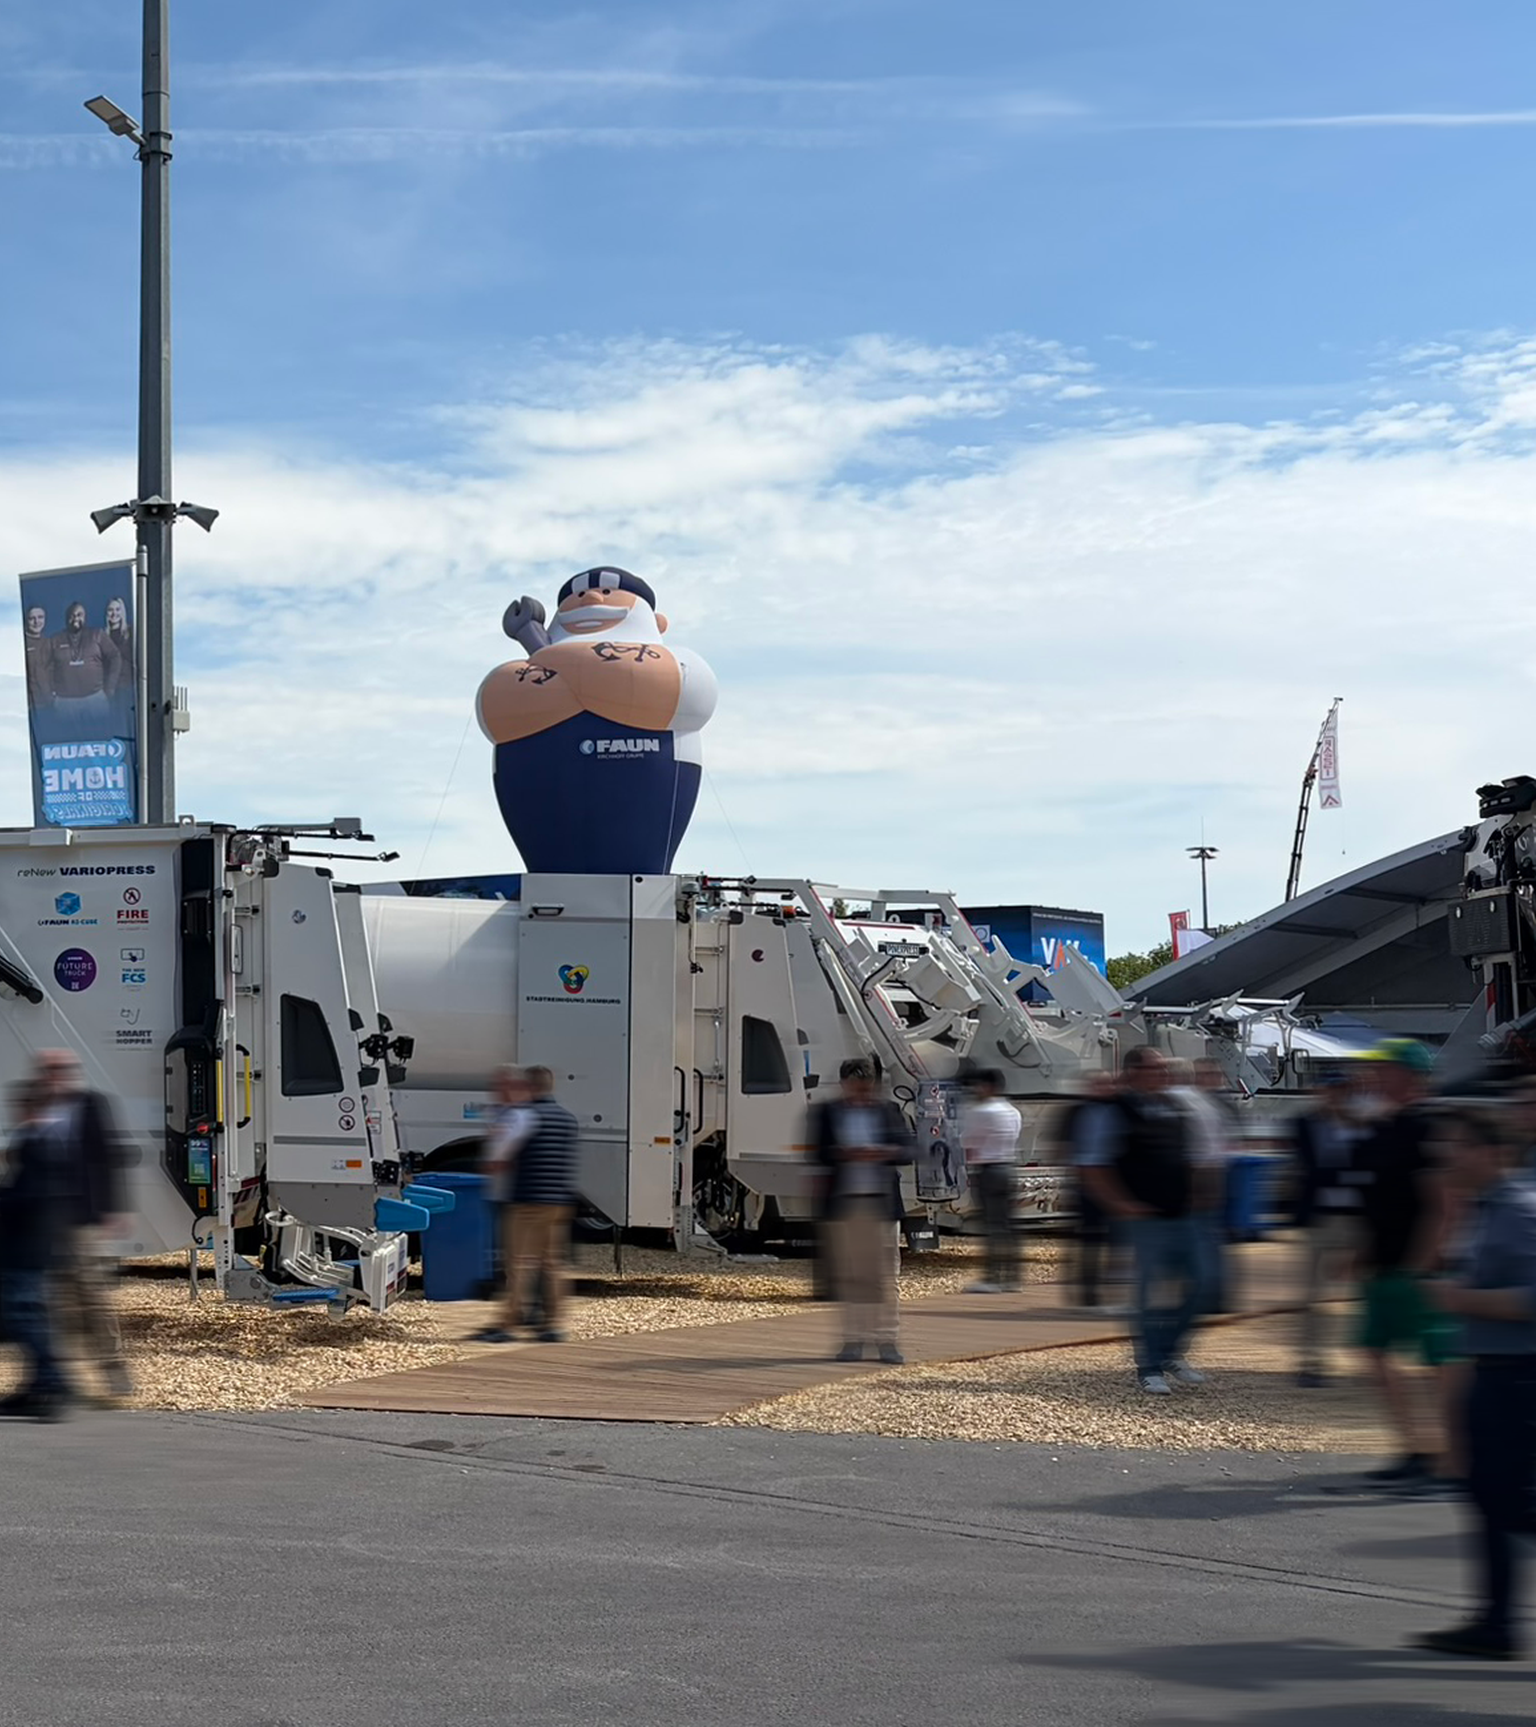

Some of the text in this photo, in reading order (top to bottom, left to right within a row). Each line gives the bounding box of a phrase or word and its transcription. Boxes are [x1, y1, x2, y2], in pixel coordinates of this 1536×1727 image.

[596, 738, 660, 753] FAUN
[17, 865, 156, 877] reNew VARIOPRESS
[117, 909, 149, 919] FIRE
[121, 973, 146, 983] FCS
